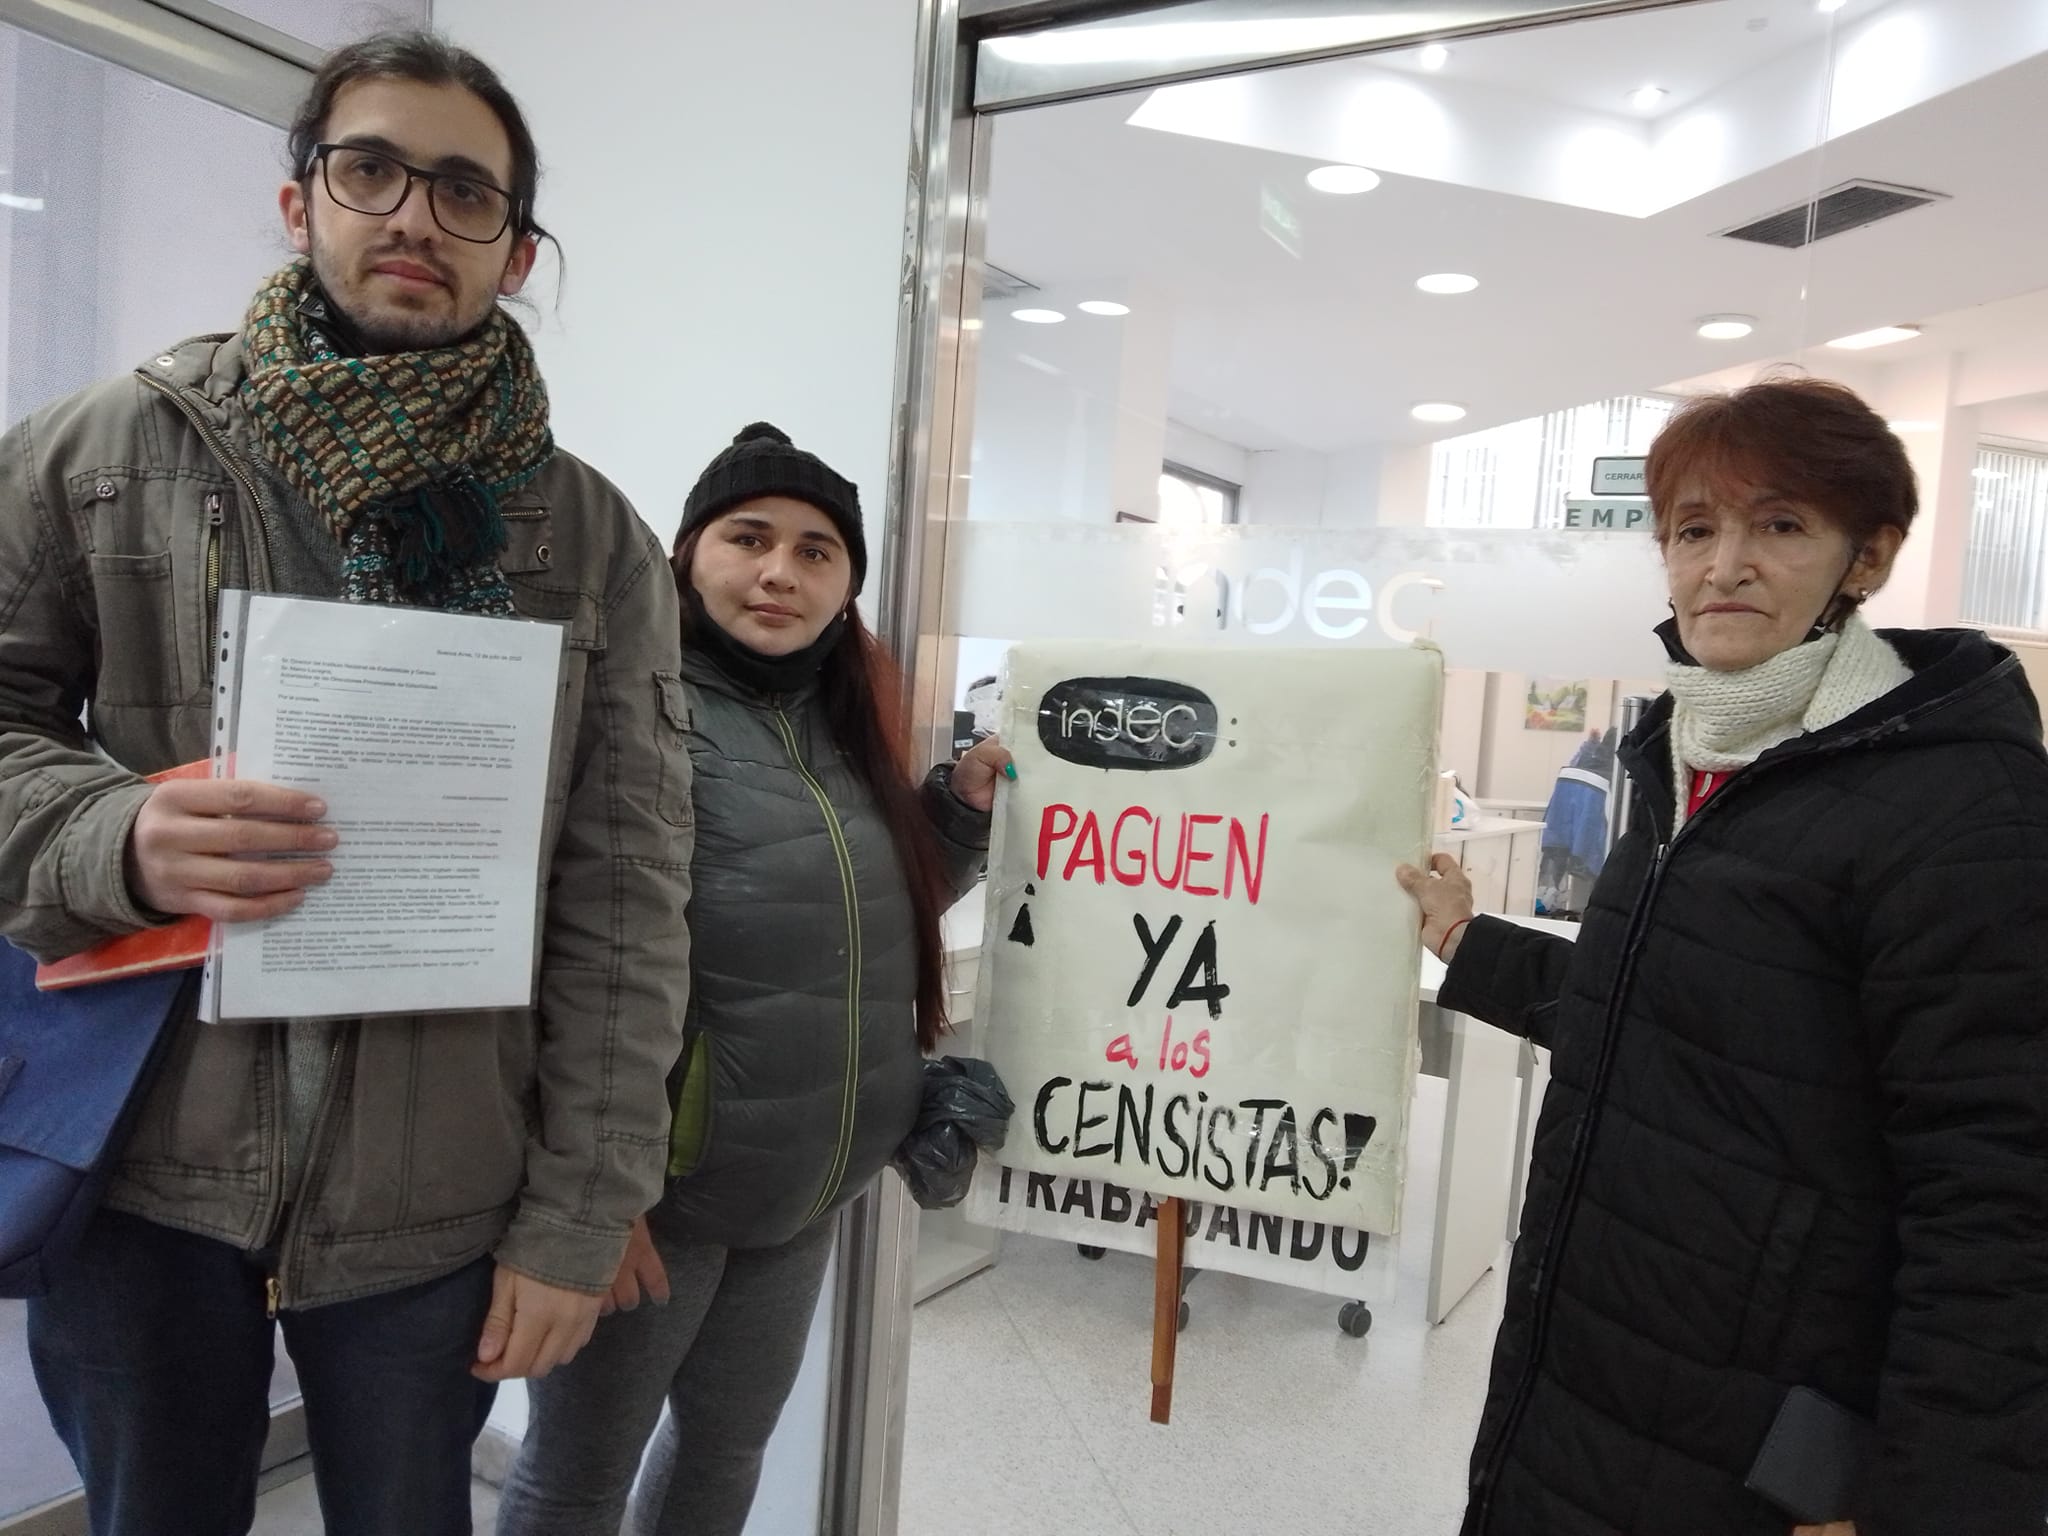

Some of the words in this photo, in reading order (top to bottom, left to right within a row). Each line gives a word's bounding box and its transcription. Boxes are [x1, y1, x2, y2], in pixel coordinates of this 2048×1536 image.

[1037, 804, 1269, 905] PAGUEN
[1105, 1034, 1138, 1071] a
[1158, 1015, 1212, 1078] los
